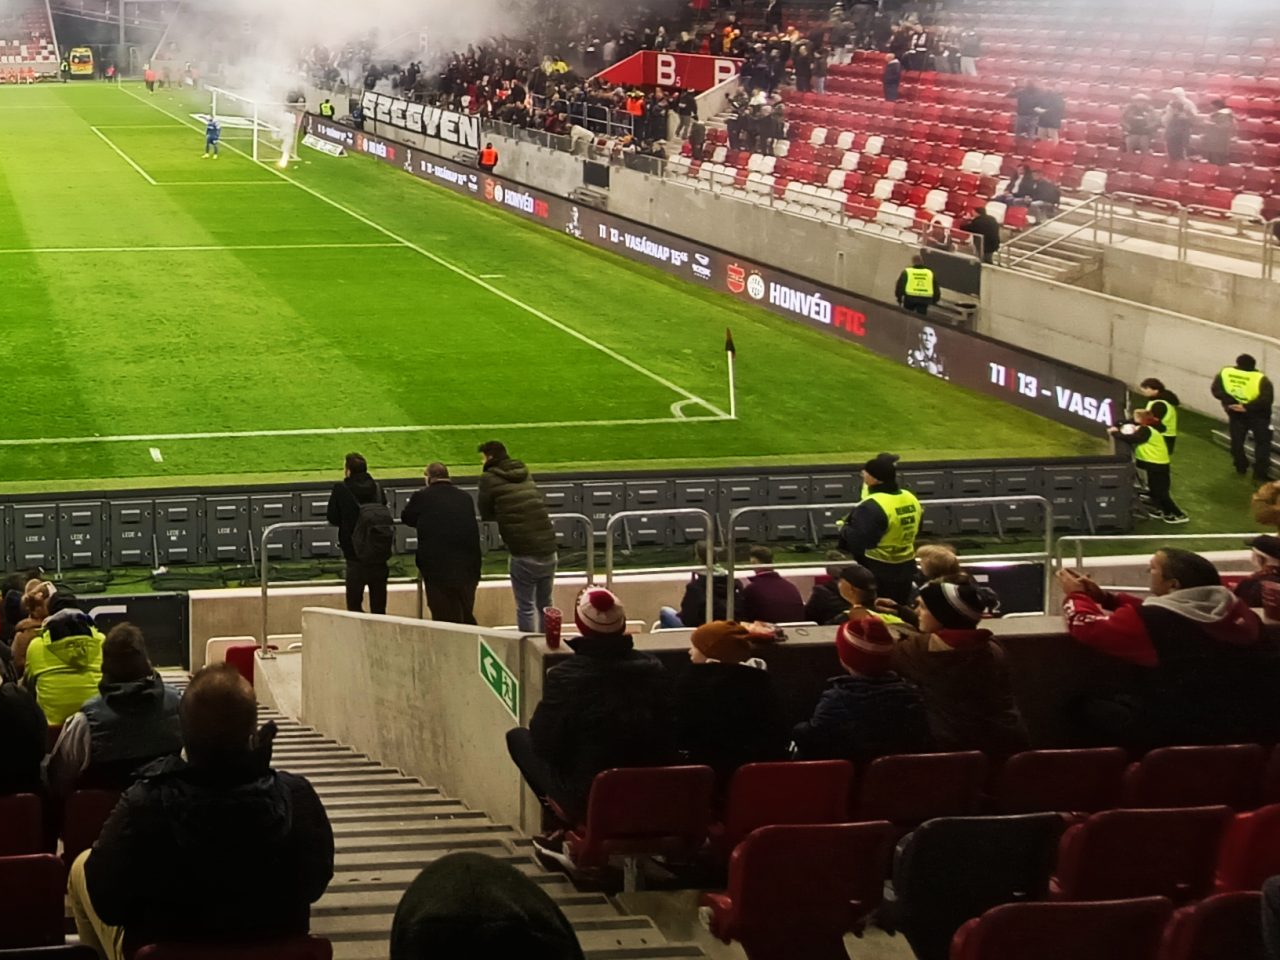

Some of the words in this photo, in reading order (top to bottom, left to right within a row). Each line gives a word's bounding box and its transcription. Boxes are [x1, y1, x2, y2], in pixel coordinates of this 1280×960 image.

[363, 91, 479, 148] SZEGYEN
[770, 282, 831, 324] HONVÉD
[833, 305, 866, 336] FTC
[1017, 372, 1038, 398] 13
[1055, 385, 1113, 426] VASÁ
